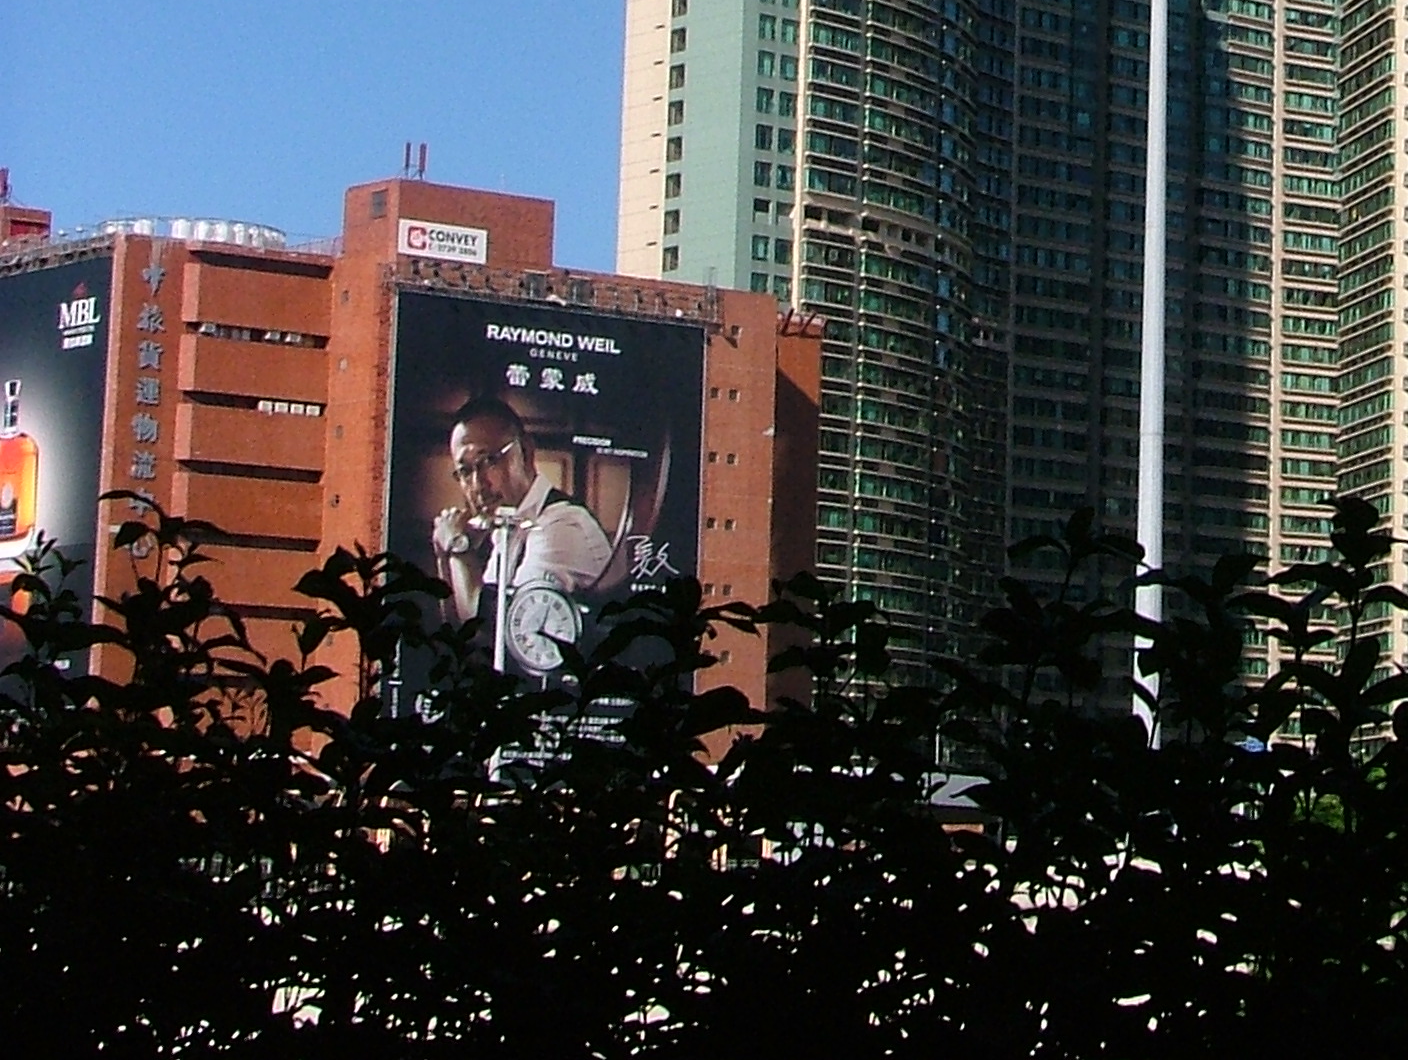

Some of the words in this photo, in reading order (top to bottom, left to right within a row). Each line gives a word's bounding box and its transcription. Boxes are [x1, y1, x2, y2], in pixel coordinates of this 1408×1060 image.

[429, 229, 478, 246] CONVEY
[58, 297, 101, 329] MBL
[486, 324, 574, 348] RAYMOND
[577, 335, 622, 354] WEIL
[529, 347, 578, 362] GENEVE
